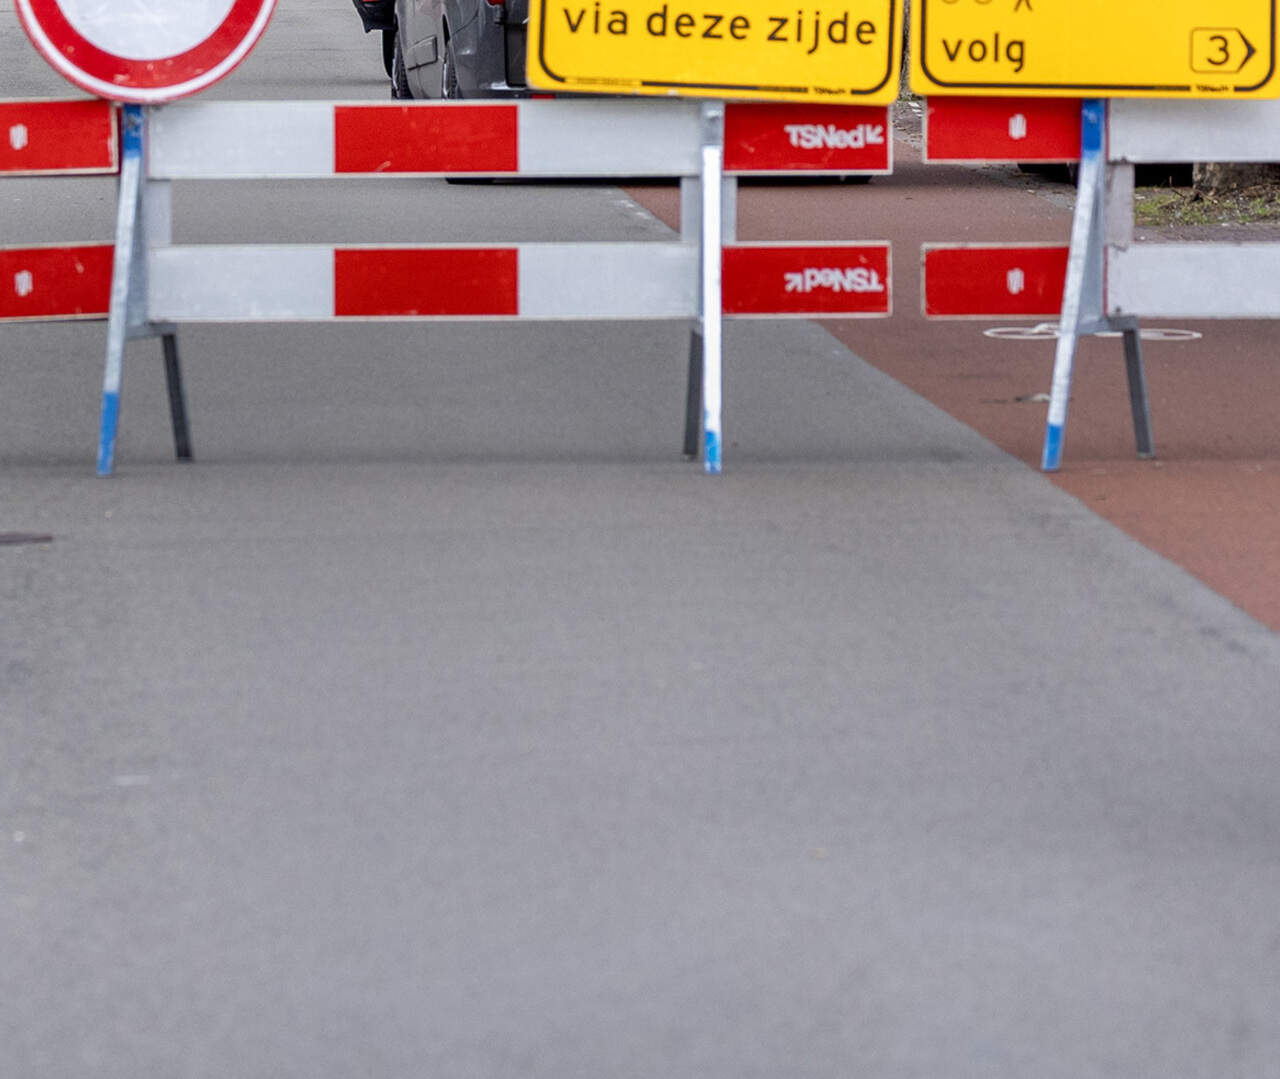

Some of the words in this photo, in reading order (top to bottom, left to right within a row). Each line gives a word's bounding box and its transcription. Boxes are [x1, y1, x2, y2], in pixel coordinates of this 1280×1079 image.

[564, 2, 628, 35] via
[646, 4, 750, 40] deze
[767, 12, 876, 54] zijde
[942, 33, 1024, 73] volg
[1207, 35, 1229, 65] 3
